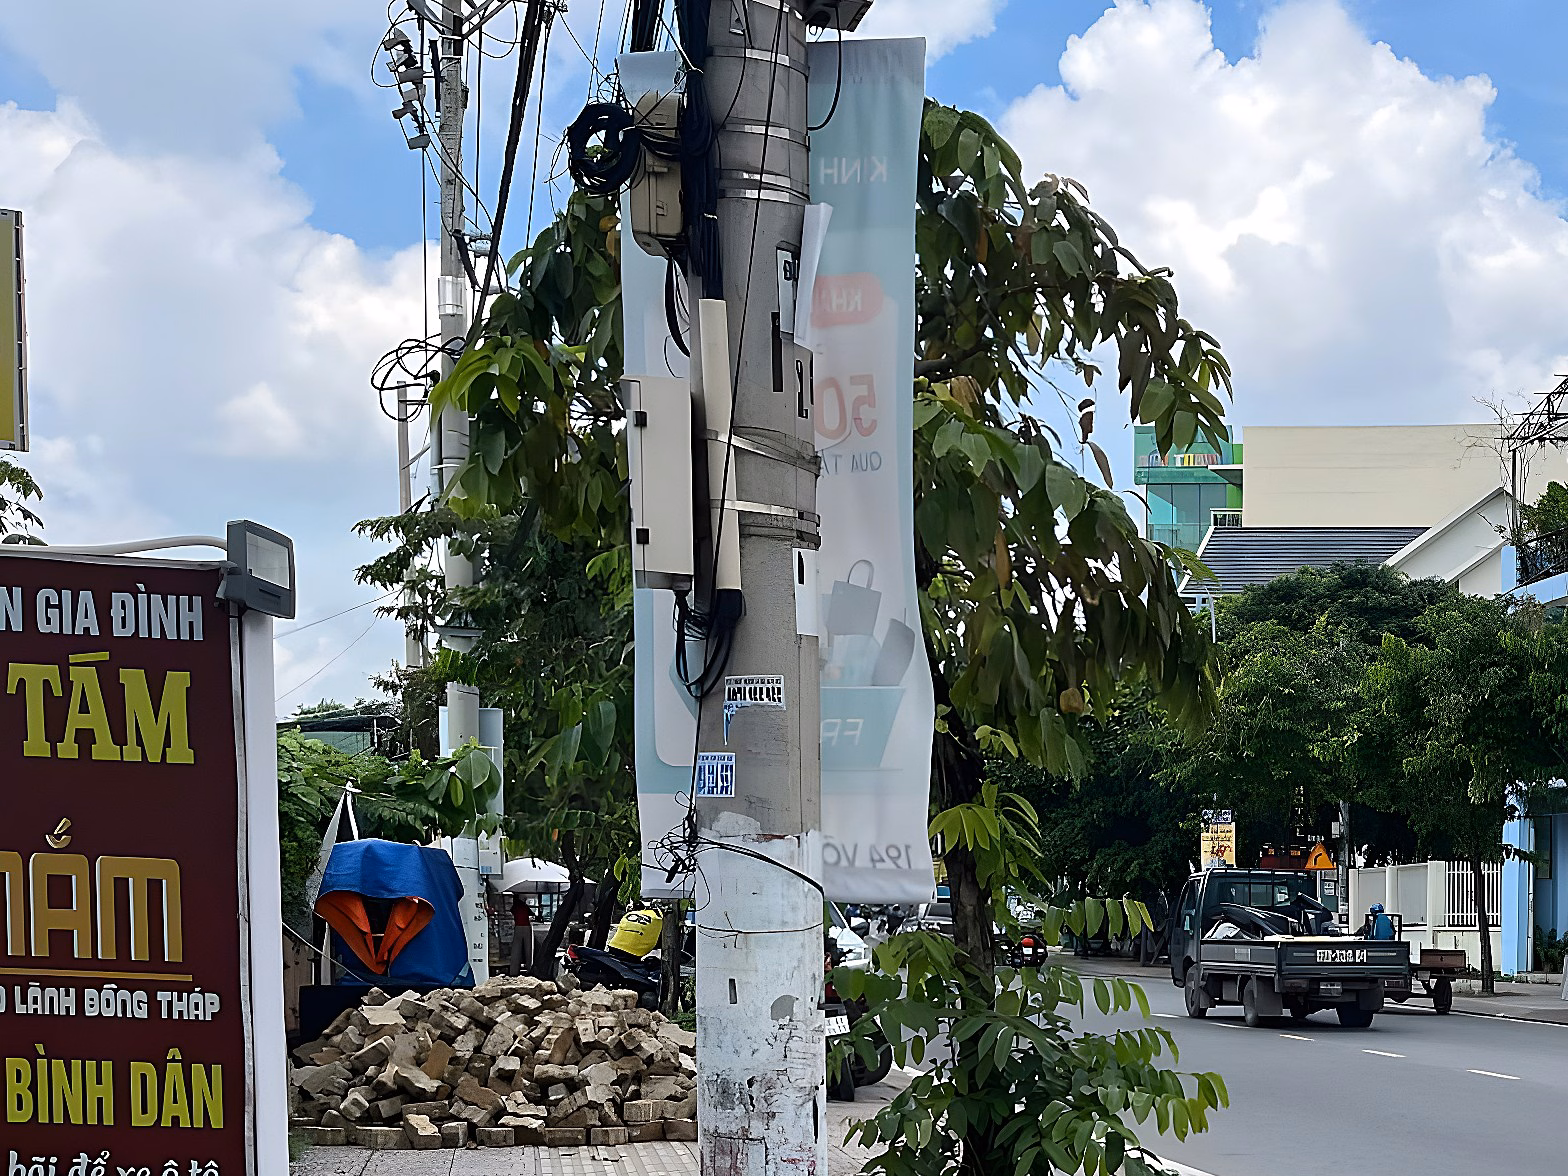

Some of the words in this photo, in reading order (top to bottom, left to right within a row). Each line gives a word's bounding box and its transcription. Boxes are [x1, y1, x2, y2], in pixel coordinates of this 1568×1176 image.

[36, 588, 100, 636] GIA
[111, 583, 204, 641] ĐÌNH
[6, 651, 195, 765] TÁM
[156, 987, 221, 1021] THÁP
[6, 1043, 114, 1126] BÌNH
[130, 1047, 224, 1129] DÂN
